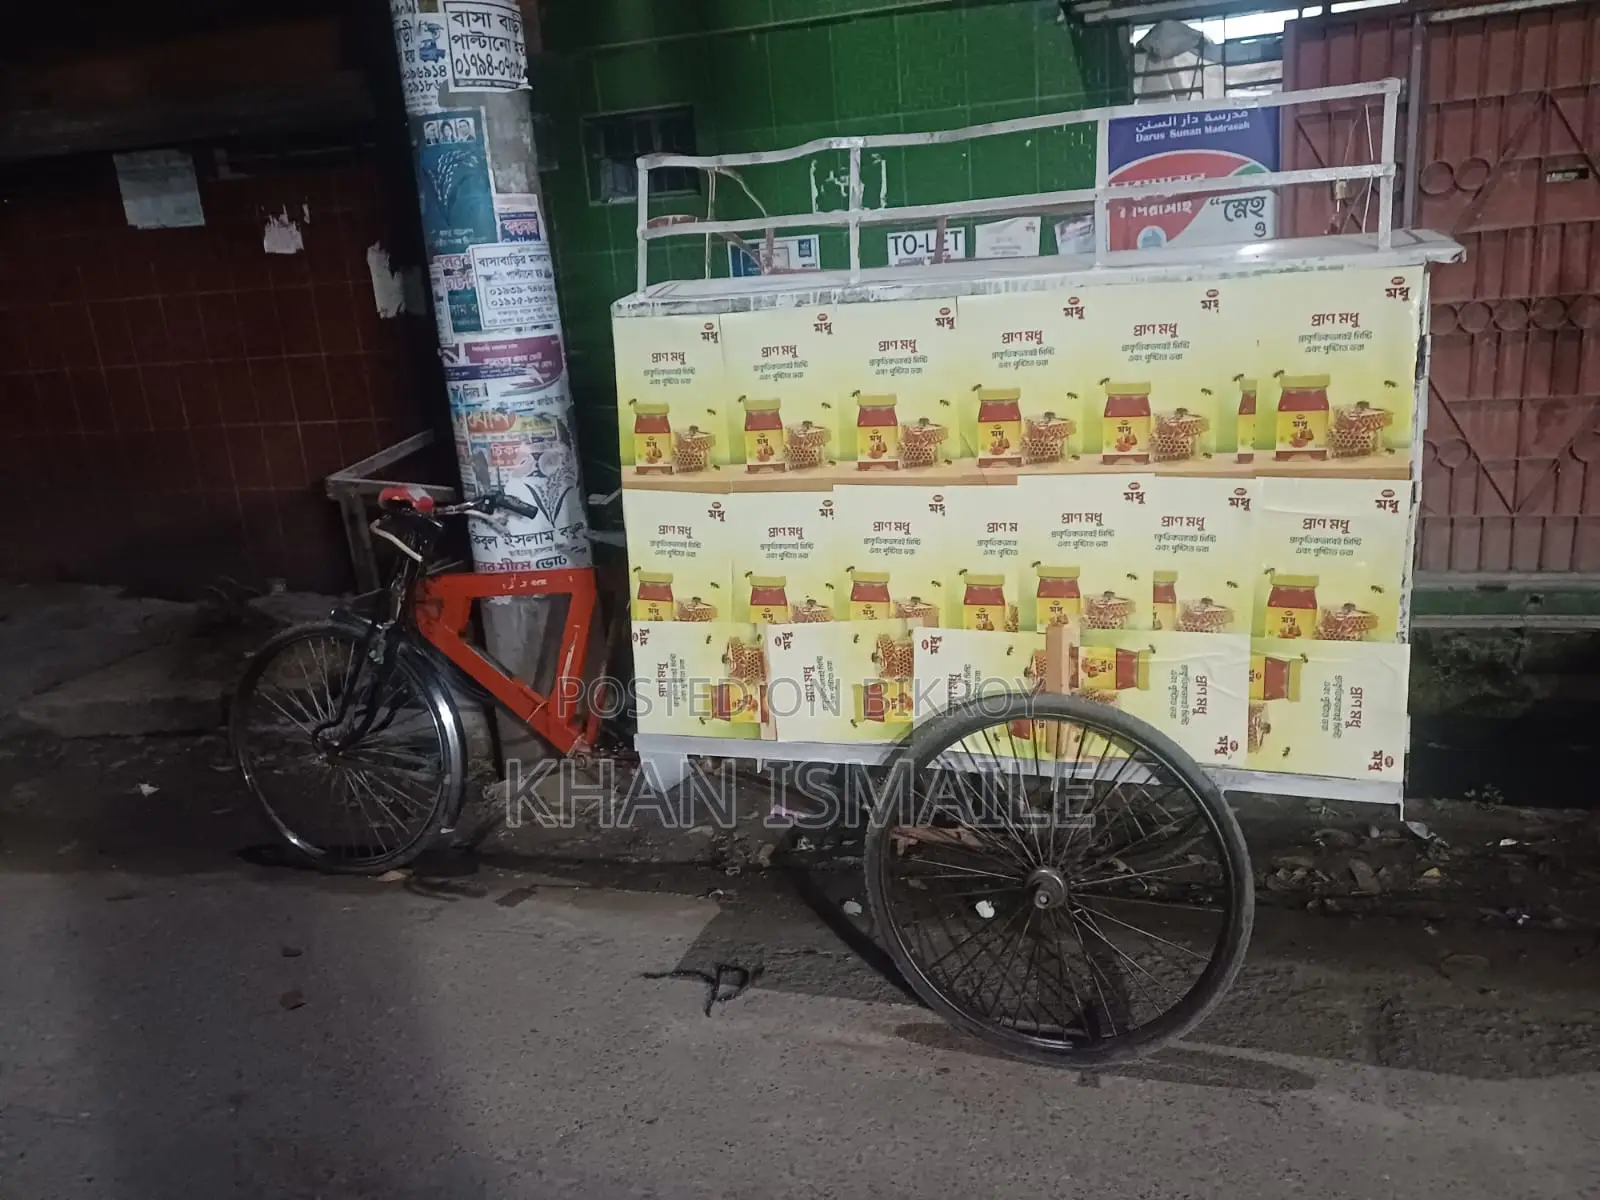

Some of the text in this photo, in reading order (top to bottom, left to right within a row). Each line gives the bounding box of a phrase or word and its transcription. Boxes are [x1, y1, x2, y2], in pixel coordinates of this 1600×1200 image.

[449, 9, 492, 28] বাসা
[1135, 110, 1249, 133] مدرسة دار السنن
[1135, 121, 1250, 143] Darus Sunan Madrasah
[1254, 221, 1267, 238] ও
[1385, 286, 1411, 302] মধু
[1063, 306, 1085, 320] মধু
[1311, 312, 1360, 329] প্রাণ মধু
[813, 321, 833, 336] মধু
[936, 316, 956, 330] মধু
[1133, 322, 1179, 339] প্রাণ মধু
[701, 331, 719, 344] মধু
[1001, 330, 1044, 345] প্রাণ মধু
[761, 344, 799, 358] প্রাণ মধু
[878, 339, 918, 353] প্রাণ মধু
[651, 351, 686, 365] প্রাণ মধু
[1123, 491, 1145, 505] মধু
[1228, 497, 1251, 512] মধু
[928, 504, 946, 517] মধু
[1375, 499, 1400, 514] মধু
[708, 509, 726, 522] মধু
[1061, 512, 1104, 527] প্রাণ মধু
[873, 521, 911, 536] প্রাণ মধু
[987, 522, 1018, 534] প্রাণ ম
[1161, 516, 1206, 532] প্রাণ মধু
[1303, 518, 1350, 534] প্রাণ মধু
[658, 525, 693, 540] প্রাণ মধু
[768, 527, 804, 541] প্রাণ মধু
[536, 555, 567, 569] ভোট
[782, 632, 793, 650] মধু
[1192, 675, 1208, 715] প্রাণ মধু
[1345, 687, 1363, 729] প্রাণ মধু
[1215, 736, 1228, 756] মধু
[1368, 750, 1384, 772] মধু
